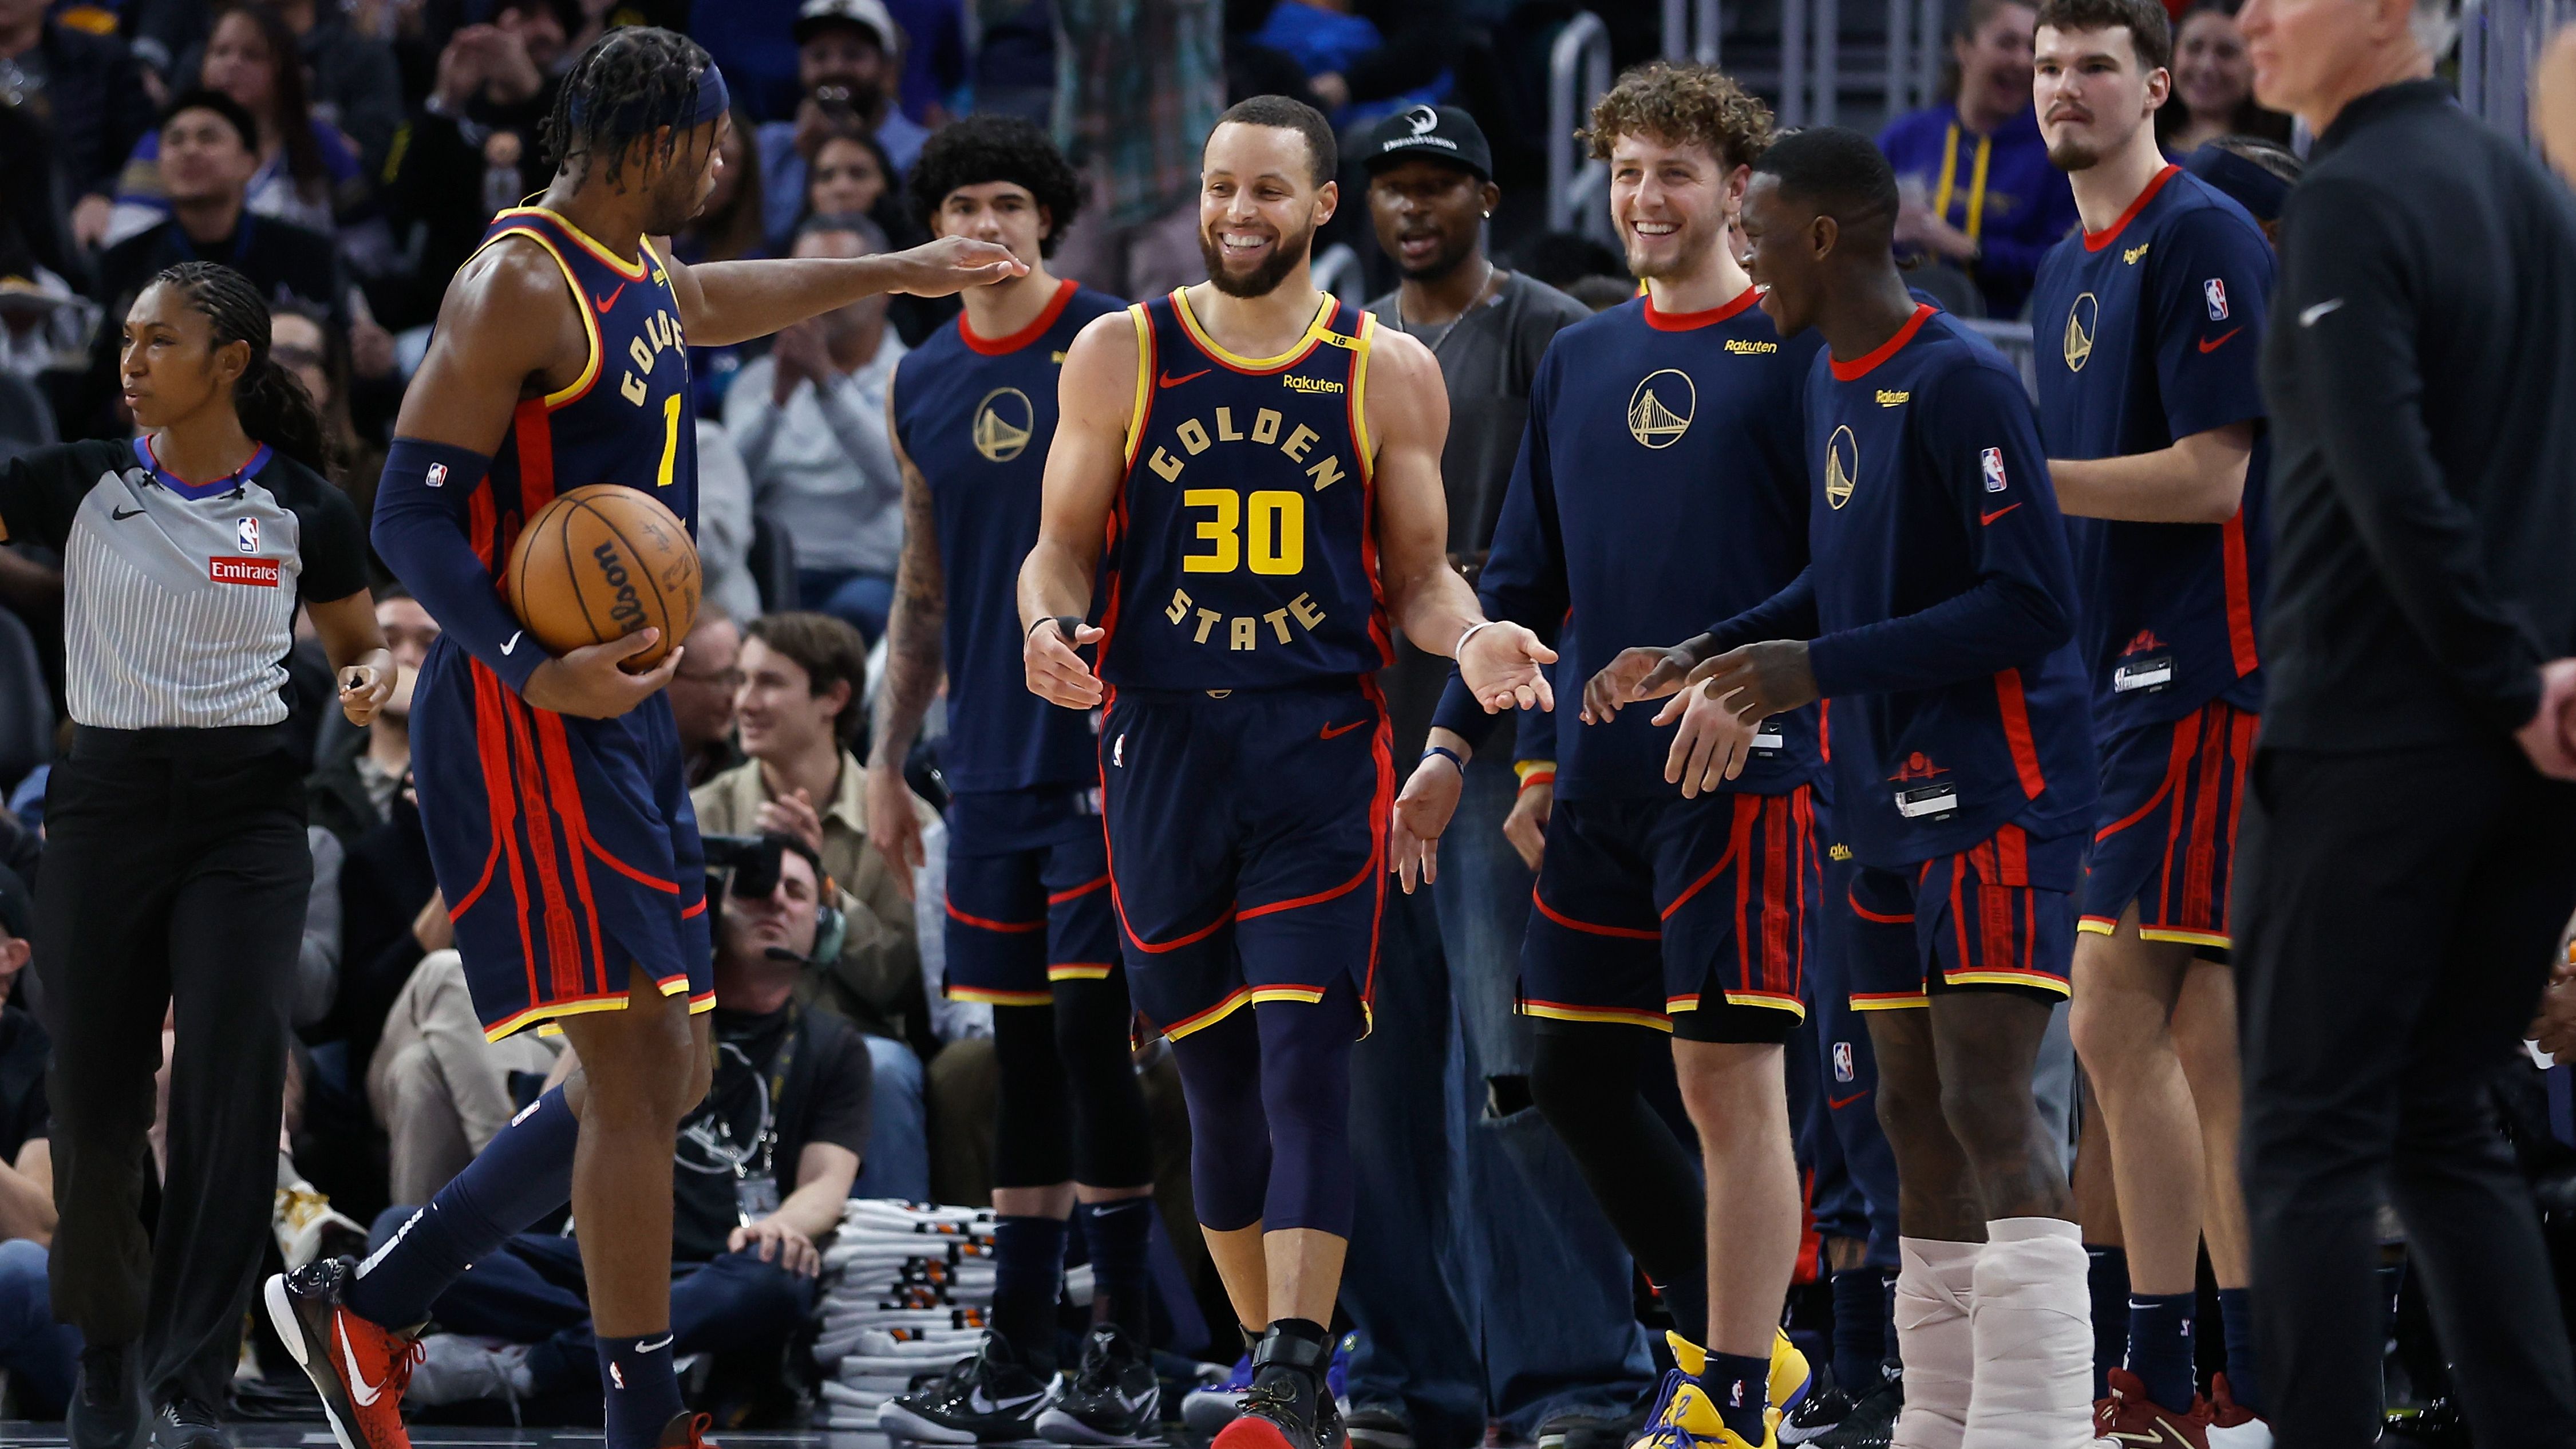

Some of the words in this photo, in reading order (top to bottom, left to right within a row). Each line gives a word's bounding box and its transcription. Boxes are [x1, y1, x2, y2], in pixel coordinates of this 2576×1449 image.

[621, 309, 689, 408] GOLDE
[1332, 335, 1346, 345] 16
[1724, 339, 1777, 354] Rakuten
[1283, 374, 1344, 393] Rakuten
[657, 393, 682, 487] 1
[1148, 406, 1346, 492] GOLDEN
[1183, 489, 1304, 575] 30
[211, 562, 278, 581] Emirates
[594, 540, 647, 633] ilson
[1165, 588, 1326, 650] STATE
